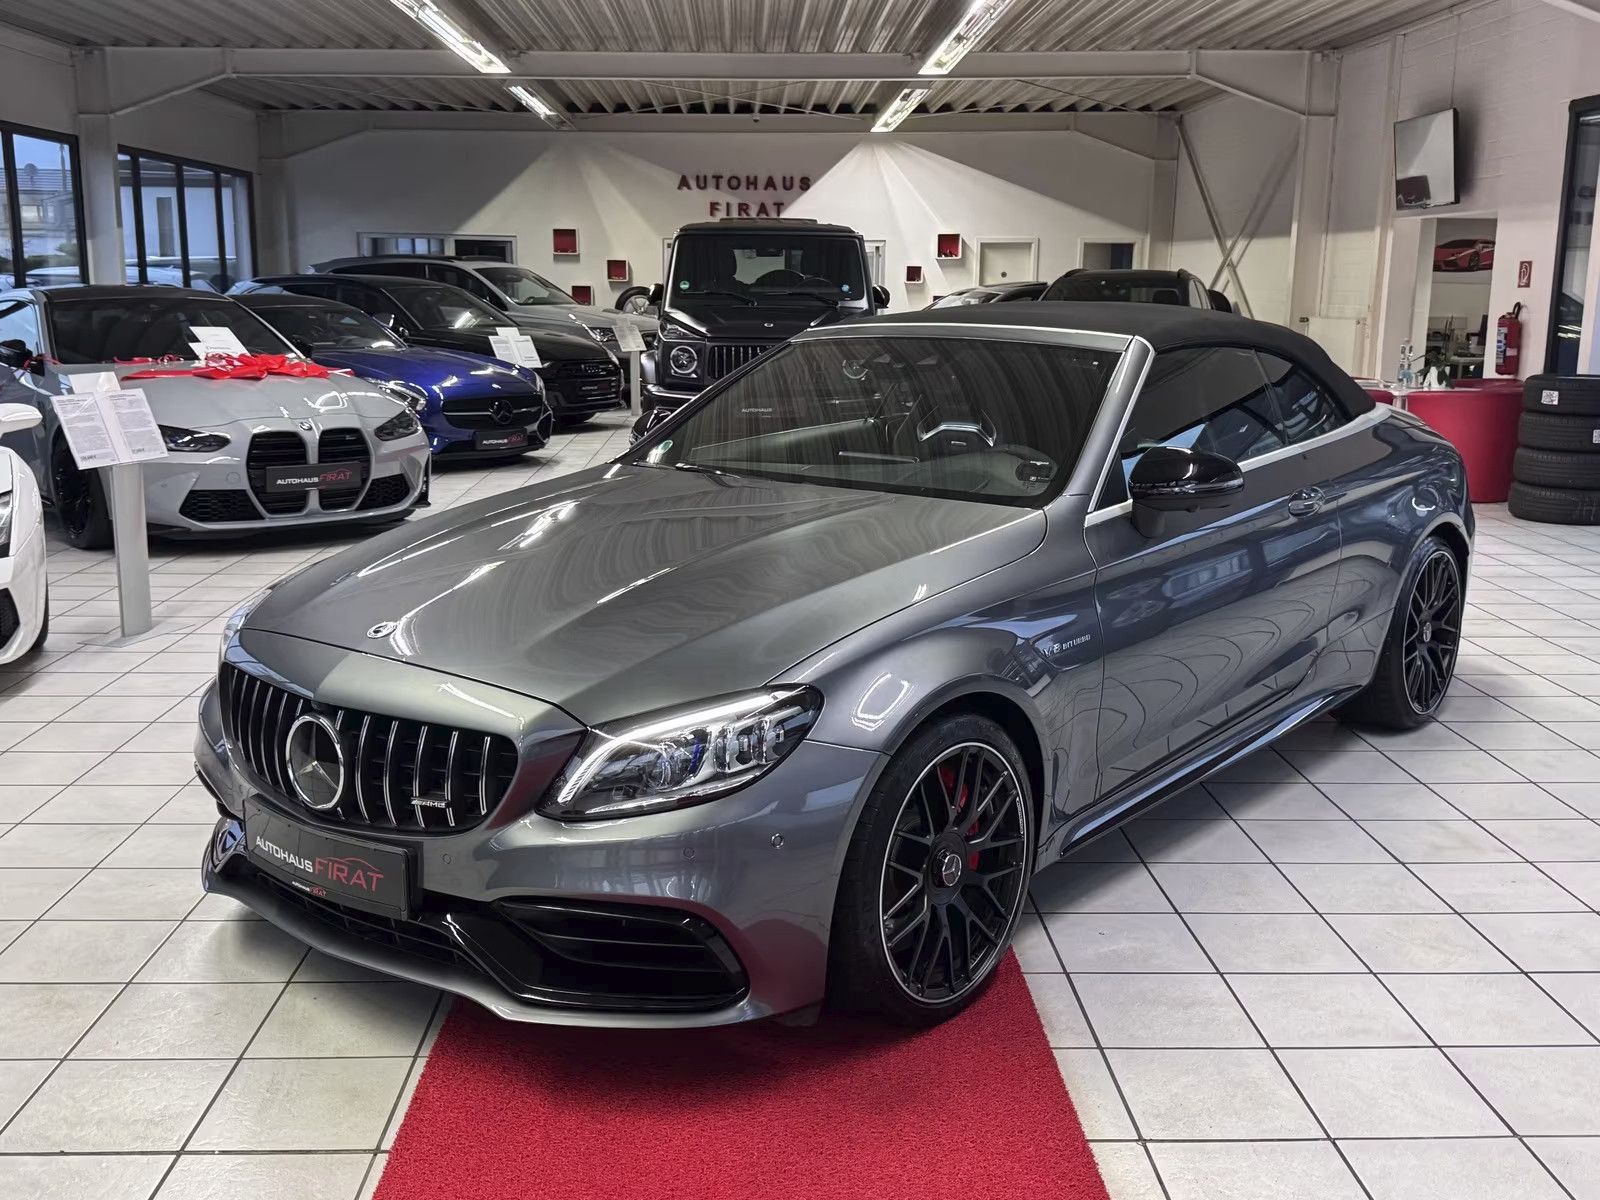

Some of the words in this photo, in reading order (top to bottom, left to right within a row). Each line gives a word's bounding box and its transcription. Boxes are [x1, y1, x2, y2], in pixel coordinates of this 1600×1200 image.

[677, 174, 812, 191] AUTOHAUS
[708, 201, 785, 217] FIRAT
[276, 477, 319, 485] AUTOHAUS
[320, 471, 352, 481] FIRAT
[1062, 634, 1091, 650] BITURBO
[256, 836, 314, 873] AUTOHAUS
[314, 858, 384, 892] FIRAT
